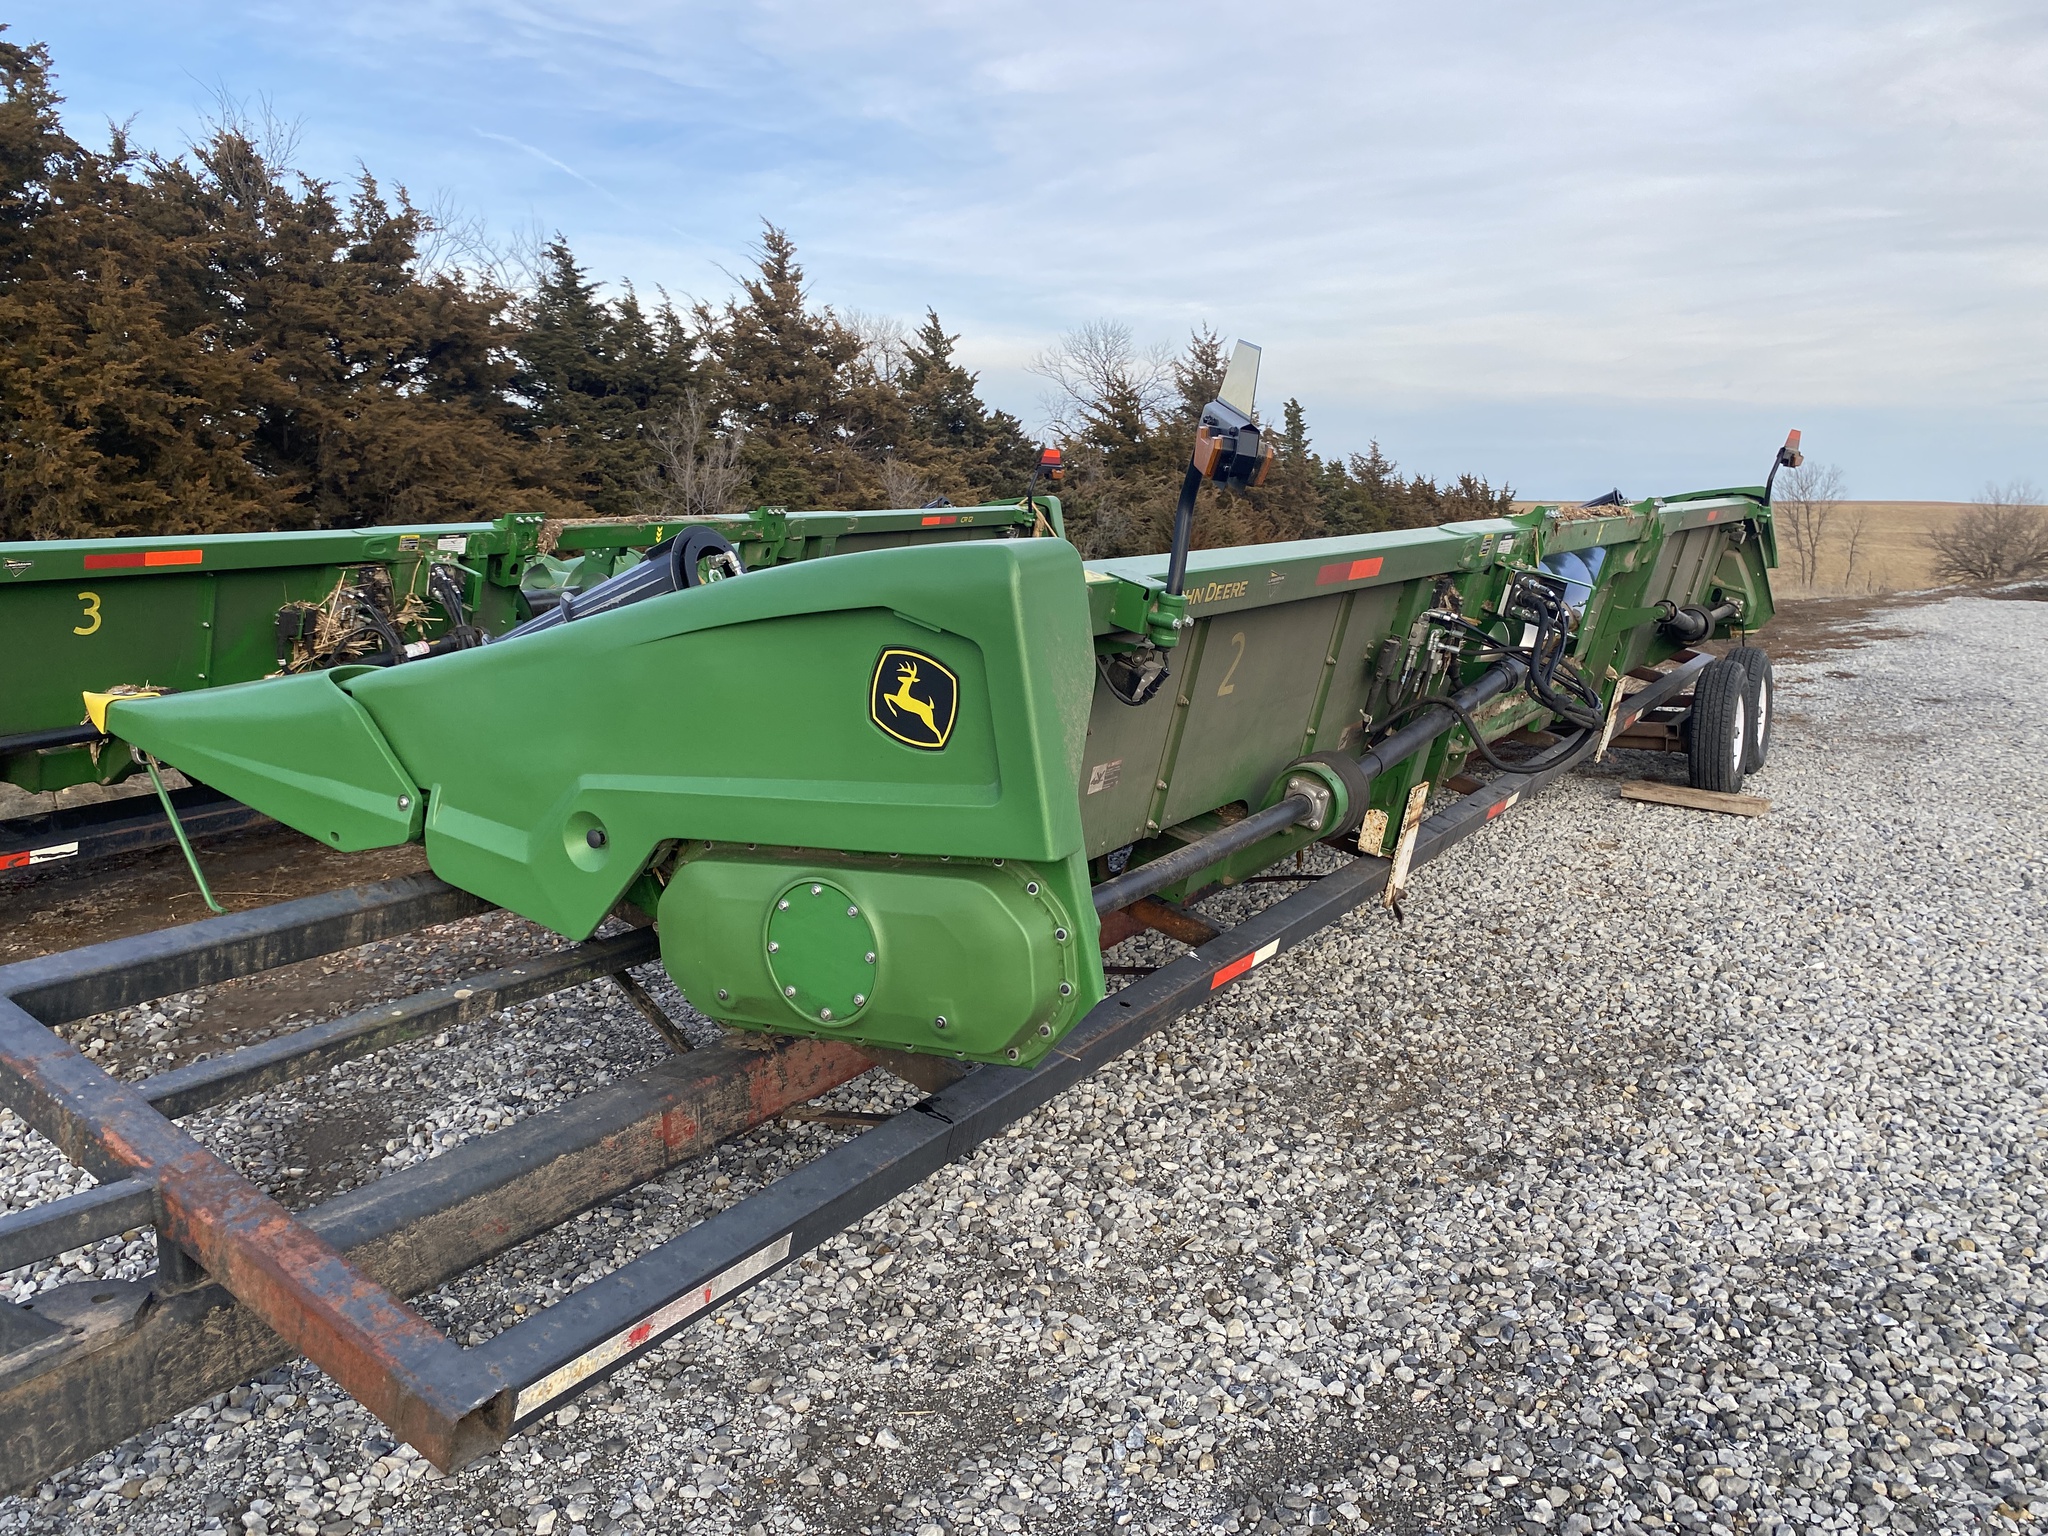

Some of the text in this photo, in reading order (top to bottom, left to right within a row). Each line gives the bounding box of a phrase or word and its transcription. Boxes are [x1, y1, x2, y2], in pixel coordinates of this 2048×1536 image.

[73, 591, 102, 636] 3
[1205, 580, 1249, 603] DEERE
[1217, 631, 1246, 697] 2
